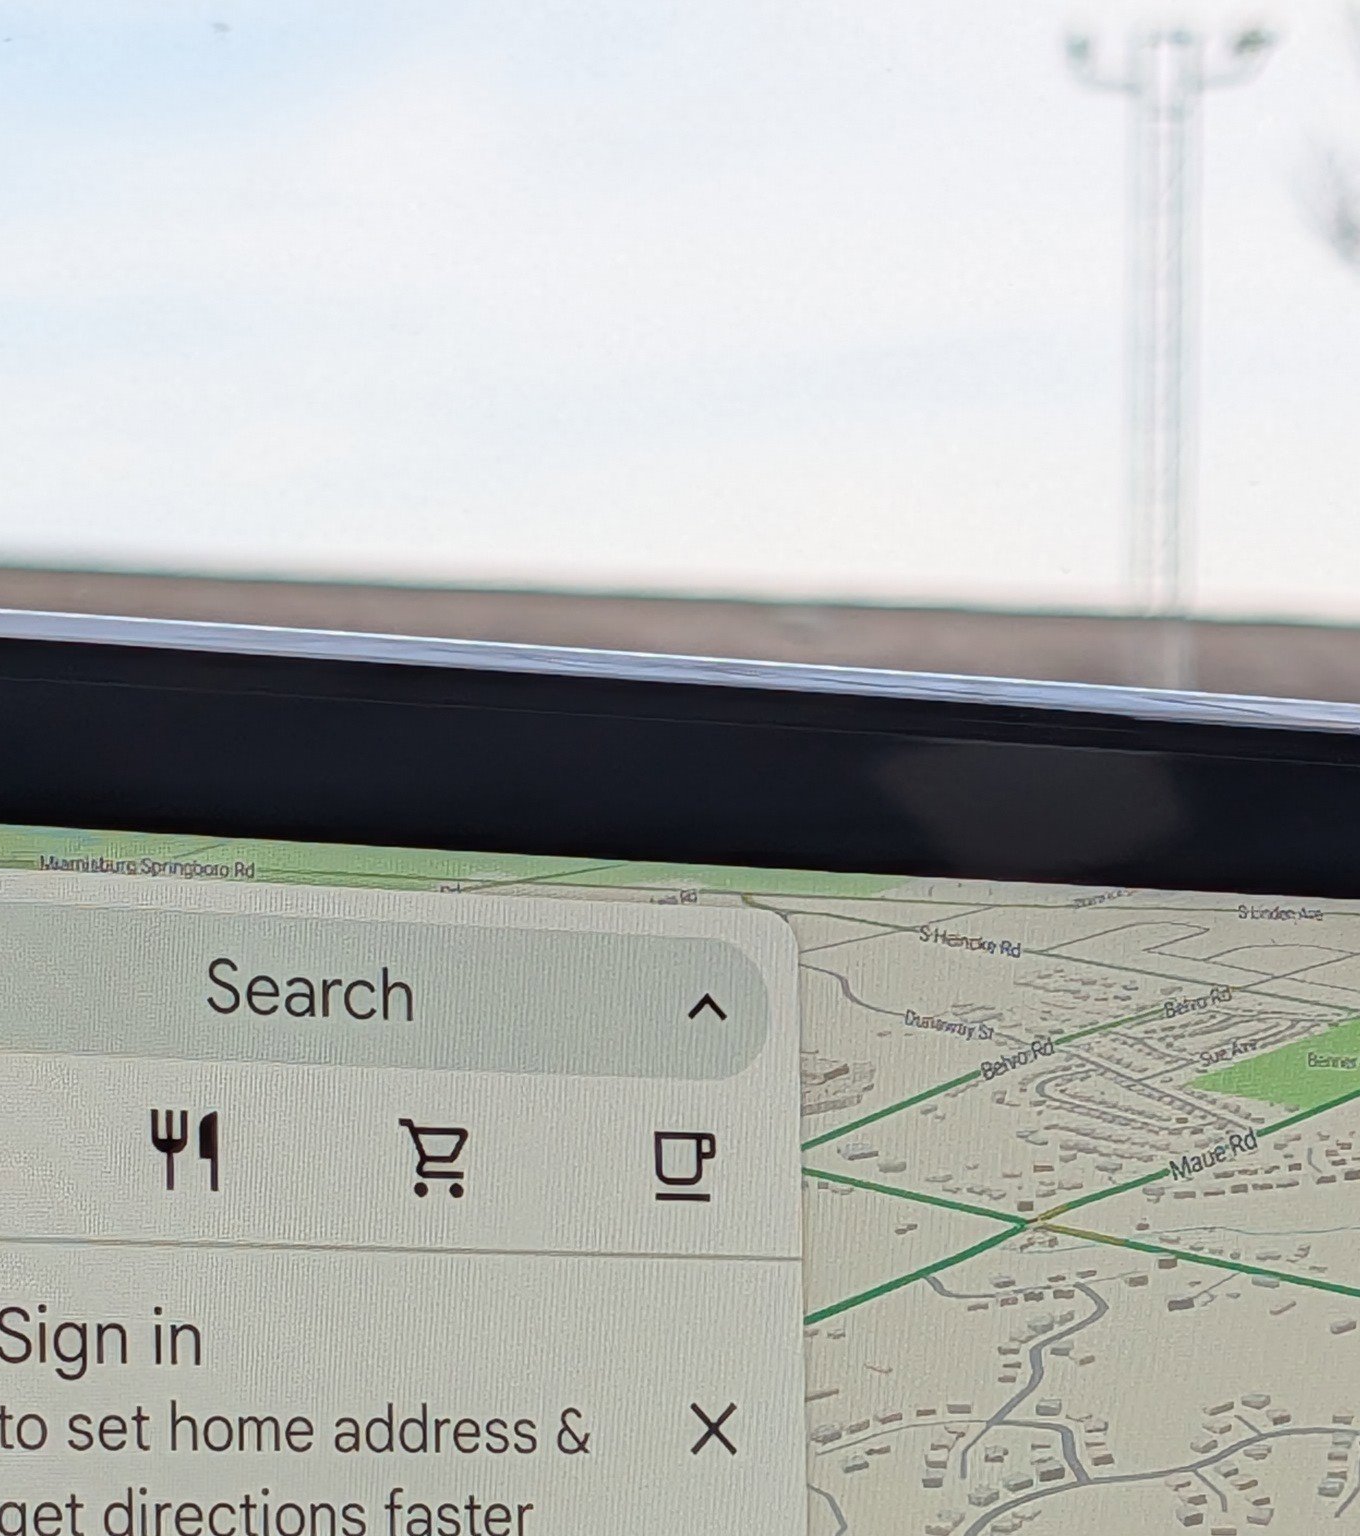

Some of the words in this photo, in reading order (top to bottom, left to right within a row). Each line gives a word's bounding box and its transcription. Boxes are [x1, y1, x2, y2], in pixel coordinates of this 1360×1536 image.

[140, 857, 230, 879] Springboro
[234, 861, 255, 879] Rd
[1238, 904, 1247, 919] S
[919, 924, 930, 943] S
[1000, 940, 1021, 958] Rd
[207, 957, 414, 1021] Search
[1210, 985, 1232, 1005] Rd
[1031, 1036, 1054, 1060] Rd
[1169, 1146, 1227, 1181] Maue
[1229, 1129, 1257, 1158] Rd
[154, 1306, 202, 1365] in
[67, 1405, 150, 1452] set
[170, 1400, 314, 1453] home
[334, 1402, 538, 1454] address
[557, 1407, 591, 1454] &
